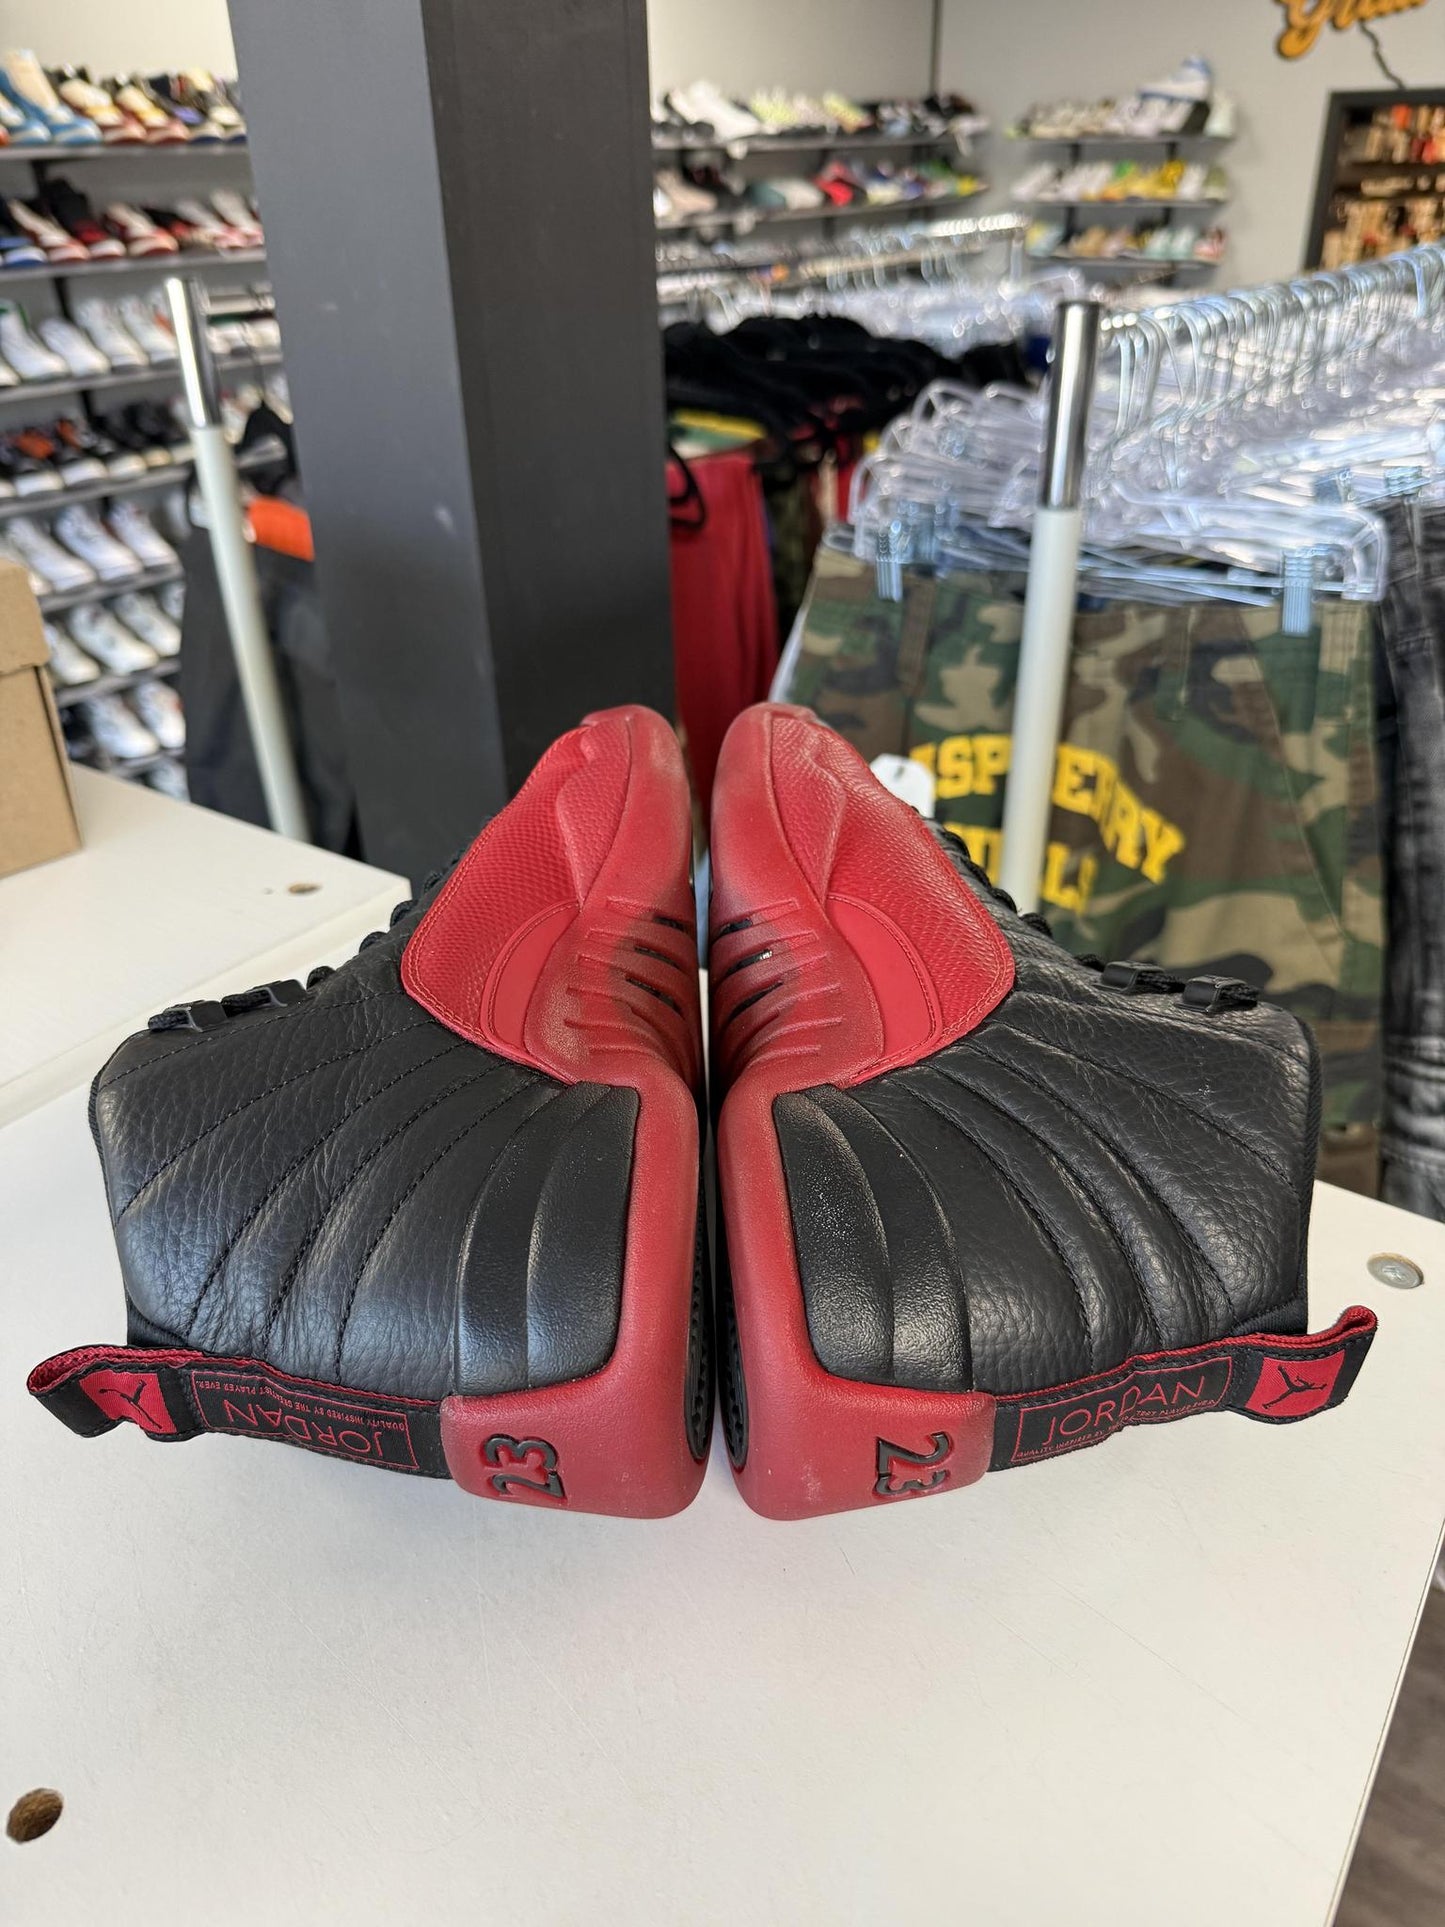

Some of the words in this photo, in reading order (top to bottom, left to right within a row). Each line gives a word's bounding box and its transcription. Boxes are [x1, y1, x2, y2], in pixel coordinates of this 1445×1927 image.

[223, 1383, 256, 1395] PLAYER
[294, 1401, 310, 1412] THE
[314, 1406, 325, 1416] BY
[1042, 1376, 1205, 1446] JORDAN
[326, 1409, 363, 1425] INSPIRED
[366, 1418, 405, 1431] QUALITY
[223, 1399, 384, 1457] JORDAN
[484, 1433, 567, 1499] 23
[875, 1431, 950, 1496] 23
